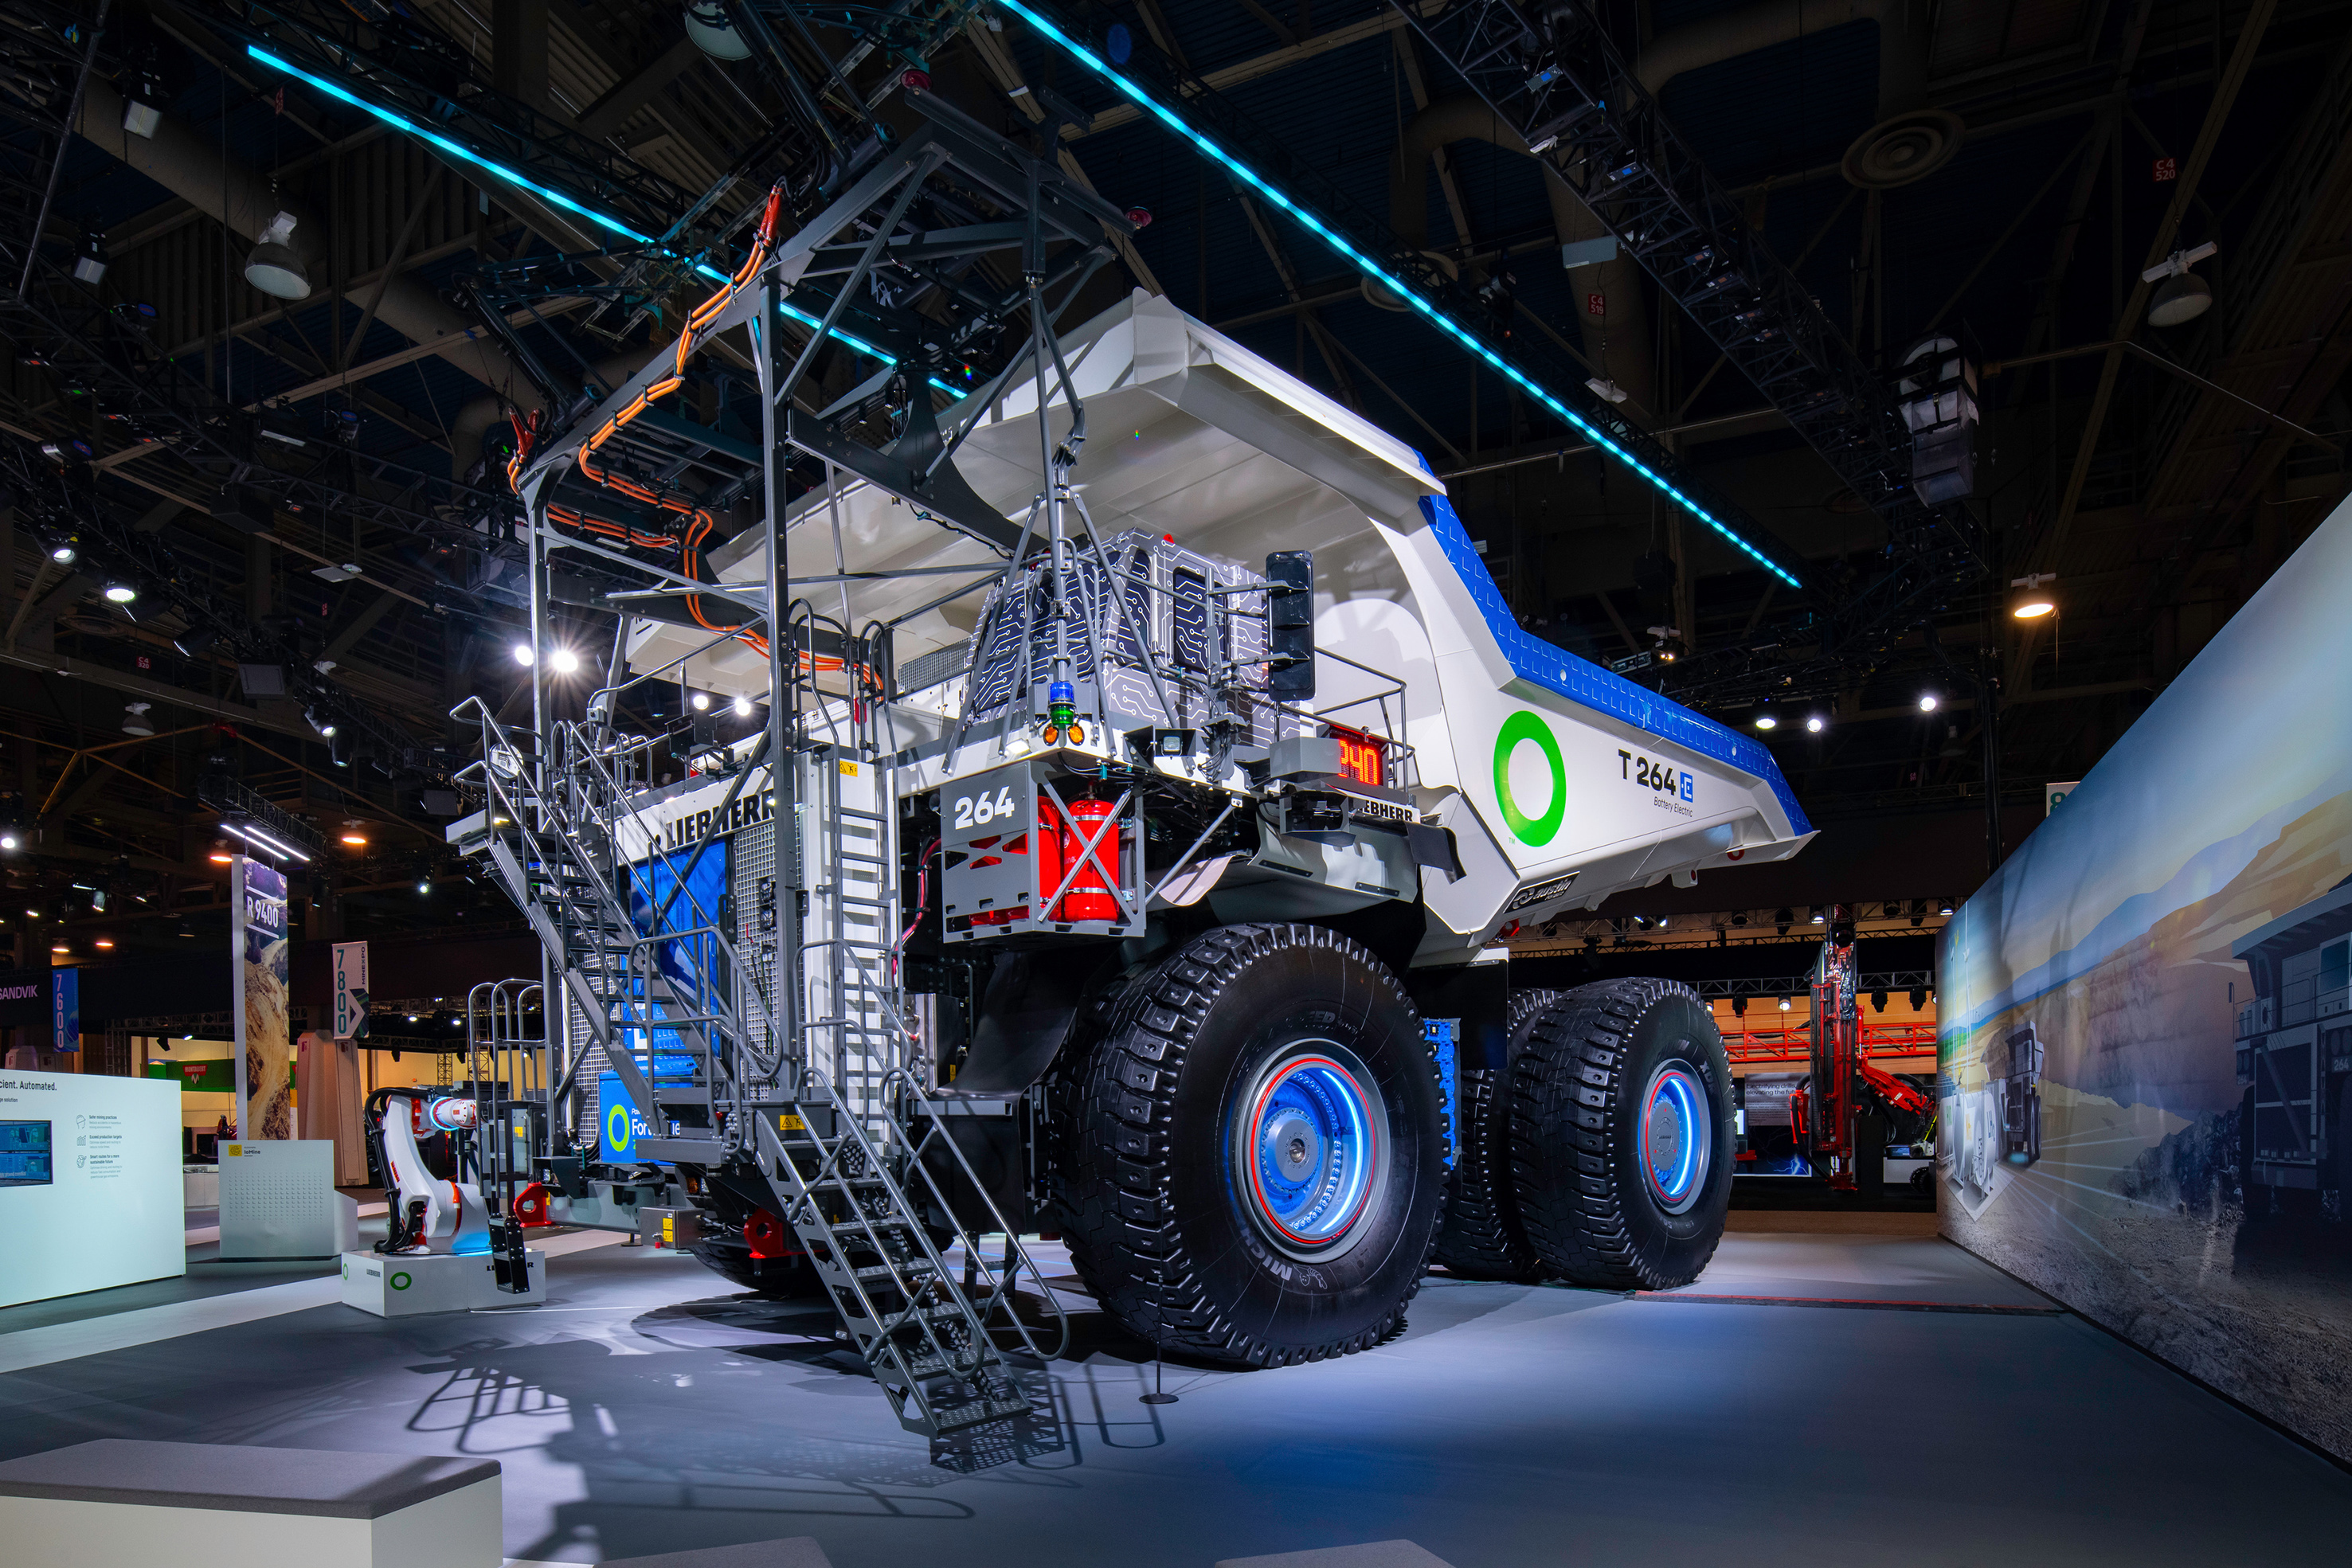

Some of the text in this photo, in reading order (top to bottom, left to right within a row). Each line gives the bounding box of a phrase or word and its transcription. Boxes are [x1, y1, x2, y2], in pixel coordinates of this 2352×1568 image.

[2156, 169, 2176, 181] 520
[1591, 304, 1604, 315] 519
[1618, 749, 1631, 780] T
[1636, 756, 1677, 796] 264
[954, 785, 1015, 830] 264
[1360, 800, 1413, 822] EBHERR
[1653, 796, 1693, 818] Battery Electric
[1533, 878, 1573, 900] austin
[247, 895, 279, 928] R 9400
[337, 948, 346, 1034] 7800
[2334, 1058, 2350, 1071] 264
[19, 1081, 57, 1091] Automated.
[1236, 1215, 1293, 1281] MICH
